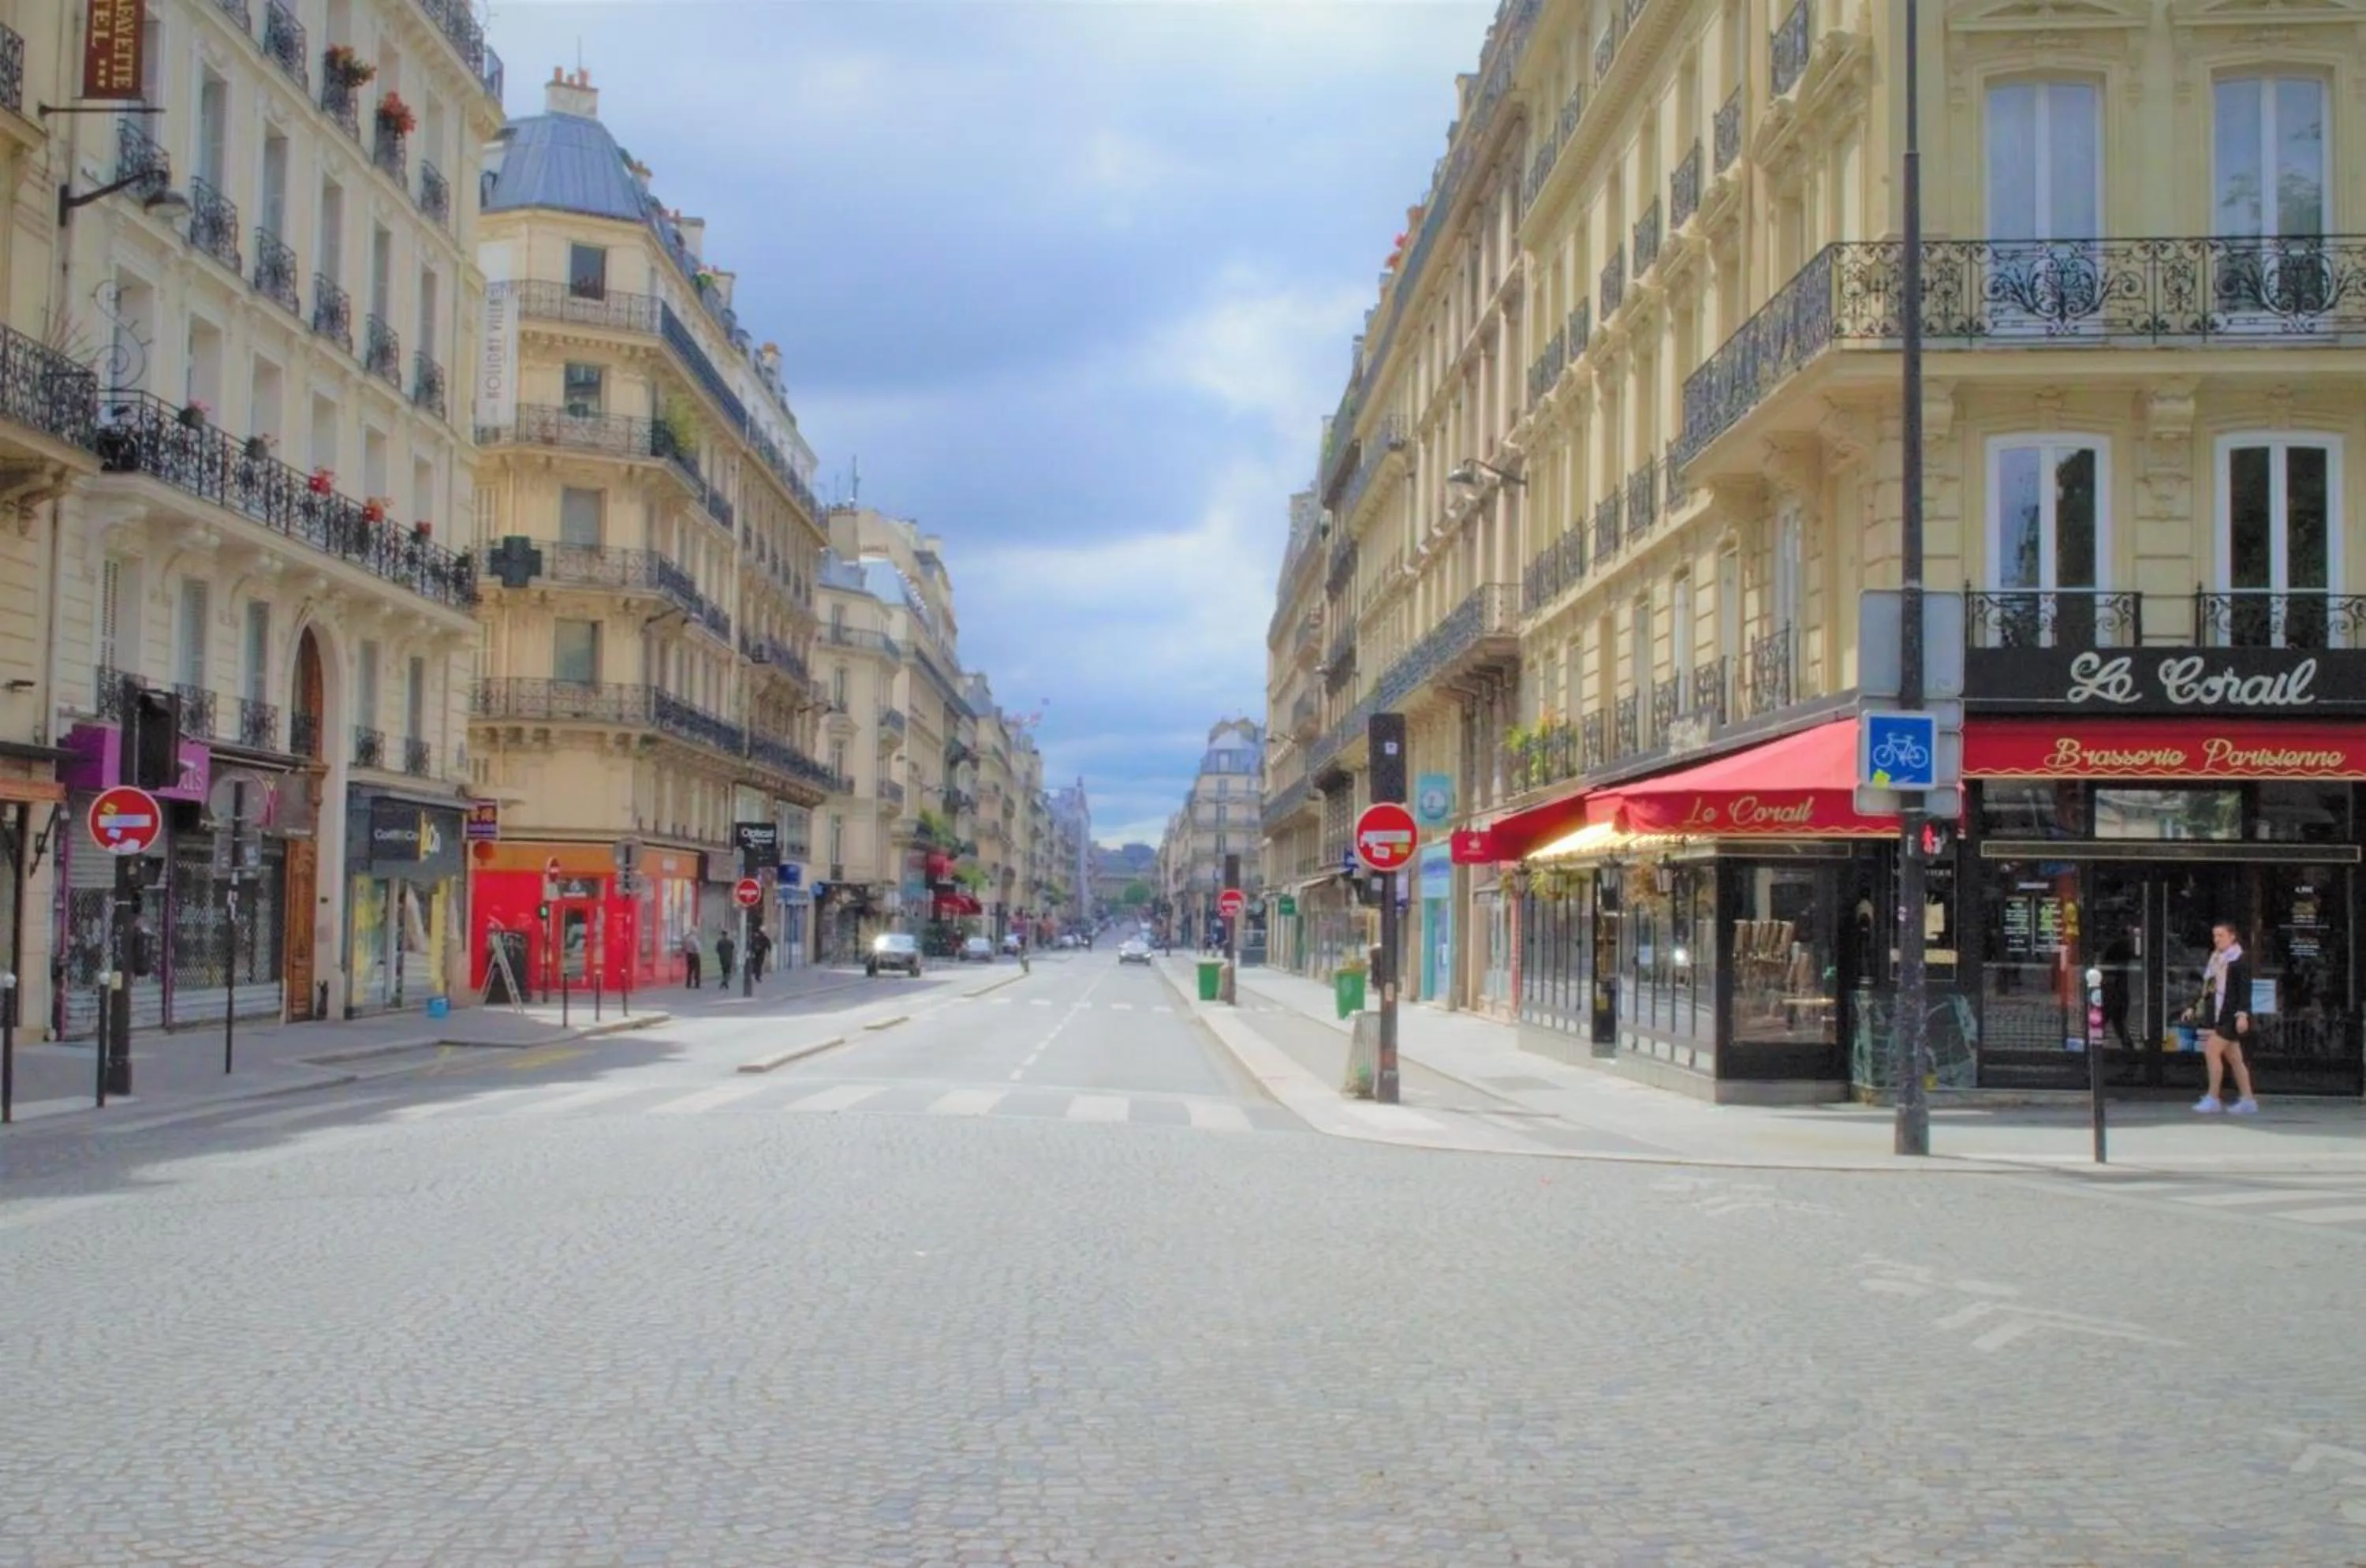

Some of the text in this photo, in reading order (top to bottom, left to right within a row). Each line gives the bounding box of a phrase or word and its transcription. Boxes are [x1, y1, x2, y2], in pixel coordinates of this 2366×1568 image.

[2067, 651, 2317, 705] Le Corail
[2043, 737, 2346, 768] Brasserie Parisienne
[1682, 795, 1816, 826] Le Corail
